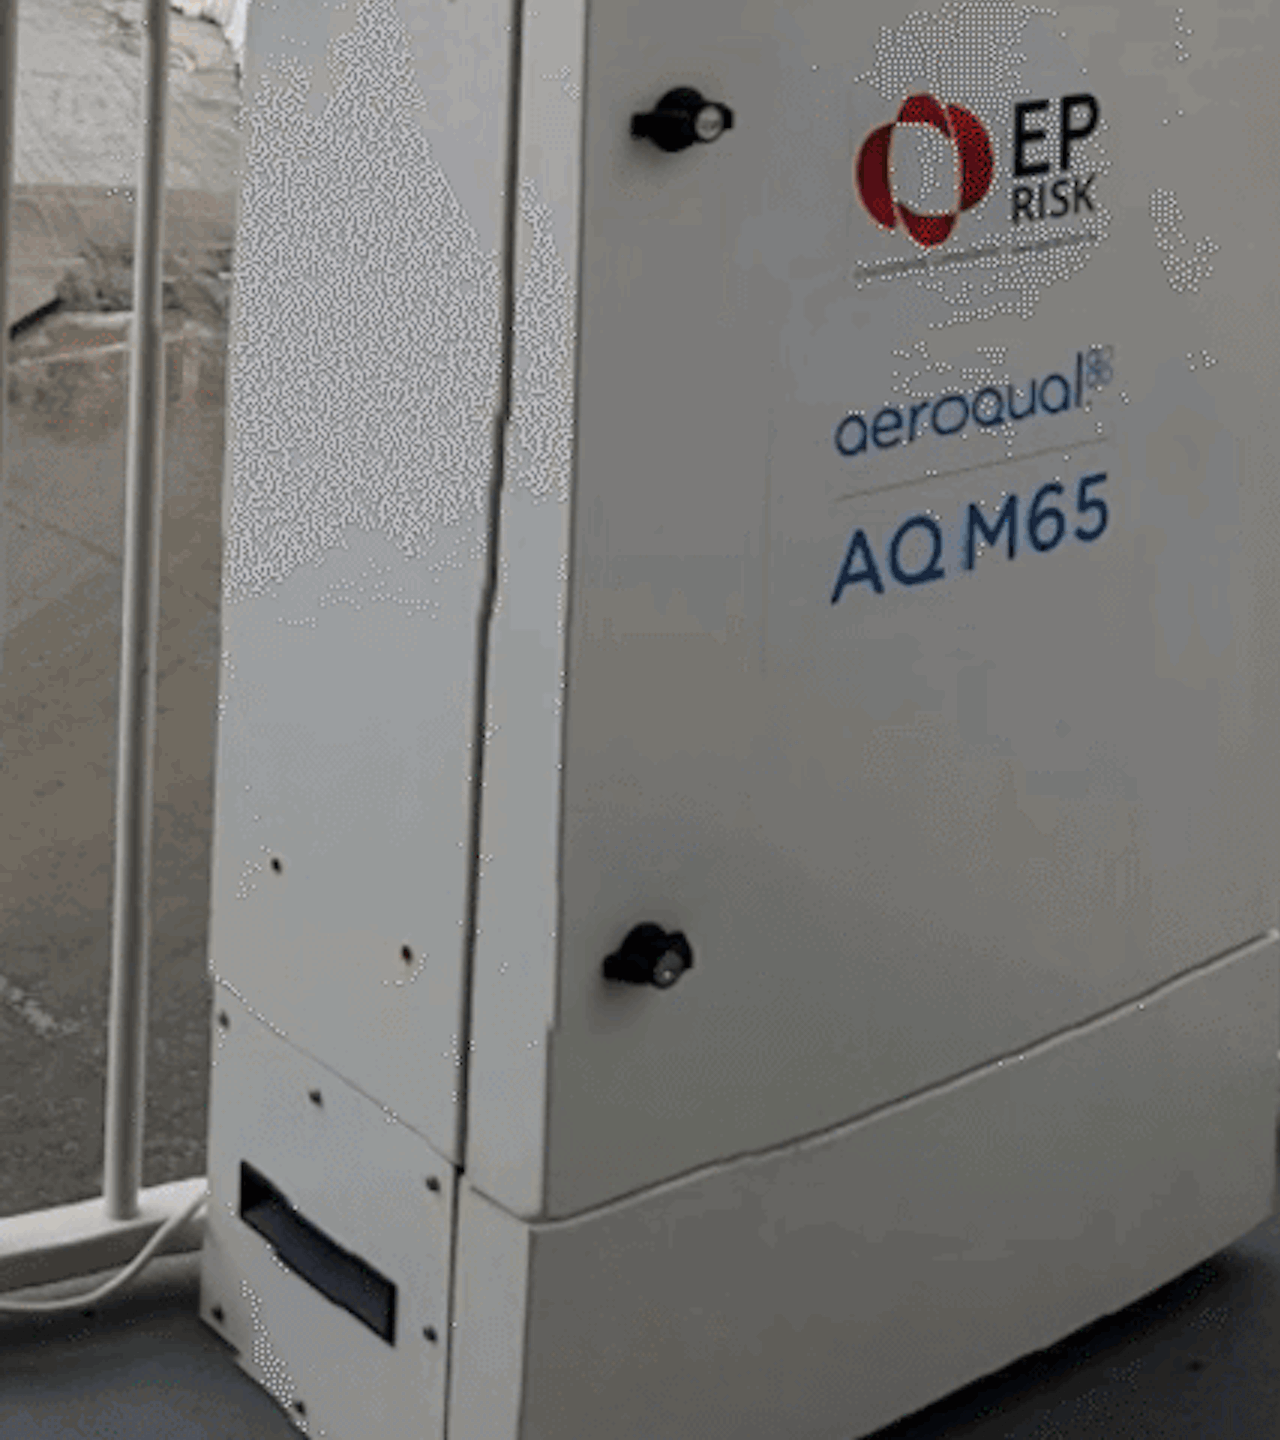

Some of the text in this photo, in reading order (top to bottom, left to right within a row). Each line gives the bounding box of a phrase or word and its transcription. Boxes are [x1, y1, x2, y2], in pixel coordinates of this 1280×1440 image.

[1013, 93, 1098, 176] EP
[1012, 171, 1096, 225] RISK
[834, 350, 1083, 456] aeroqual
